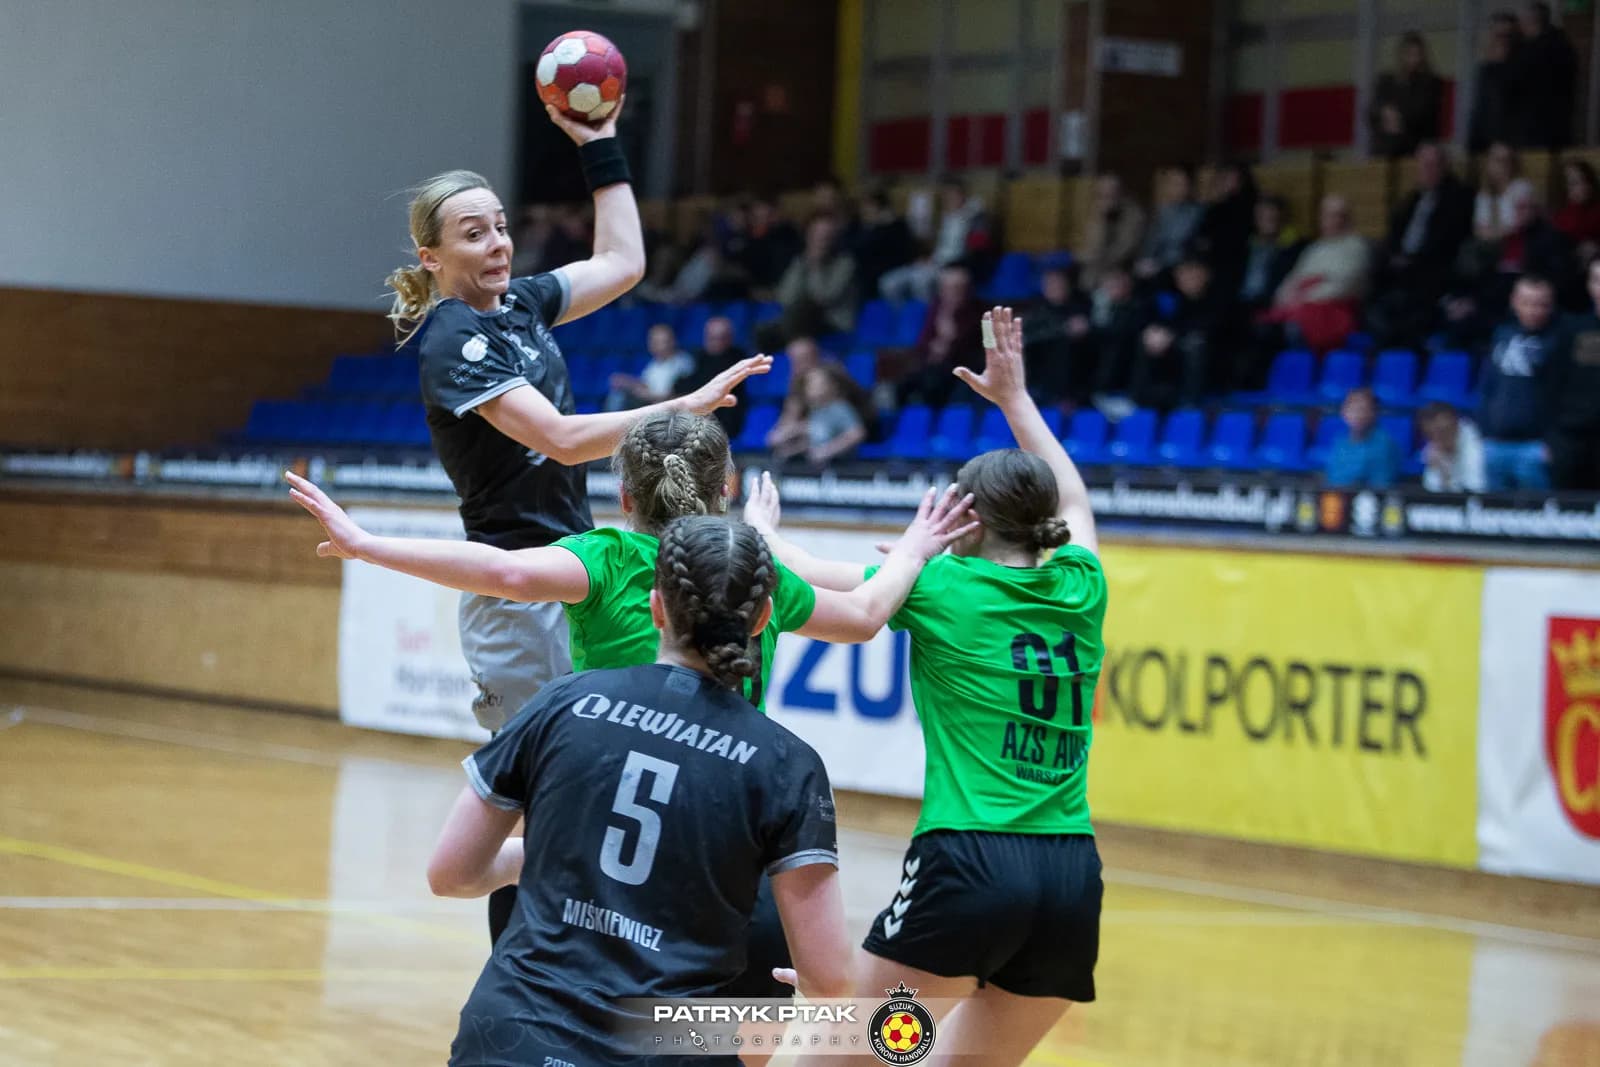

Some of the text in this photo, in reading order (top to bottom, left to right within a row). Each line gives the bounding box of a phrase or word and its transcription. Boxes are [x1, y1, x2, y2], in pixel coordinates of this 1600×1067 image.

[606, 700, 759, 765] LEWIATAN
[1103, 647, 1429, 757] KOLPORTER
[1001, 721, 1047, 765] AZS
[600, 750, 679, 886] 5
[562, 898, 664, 952] MIŚKIEWICZ
